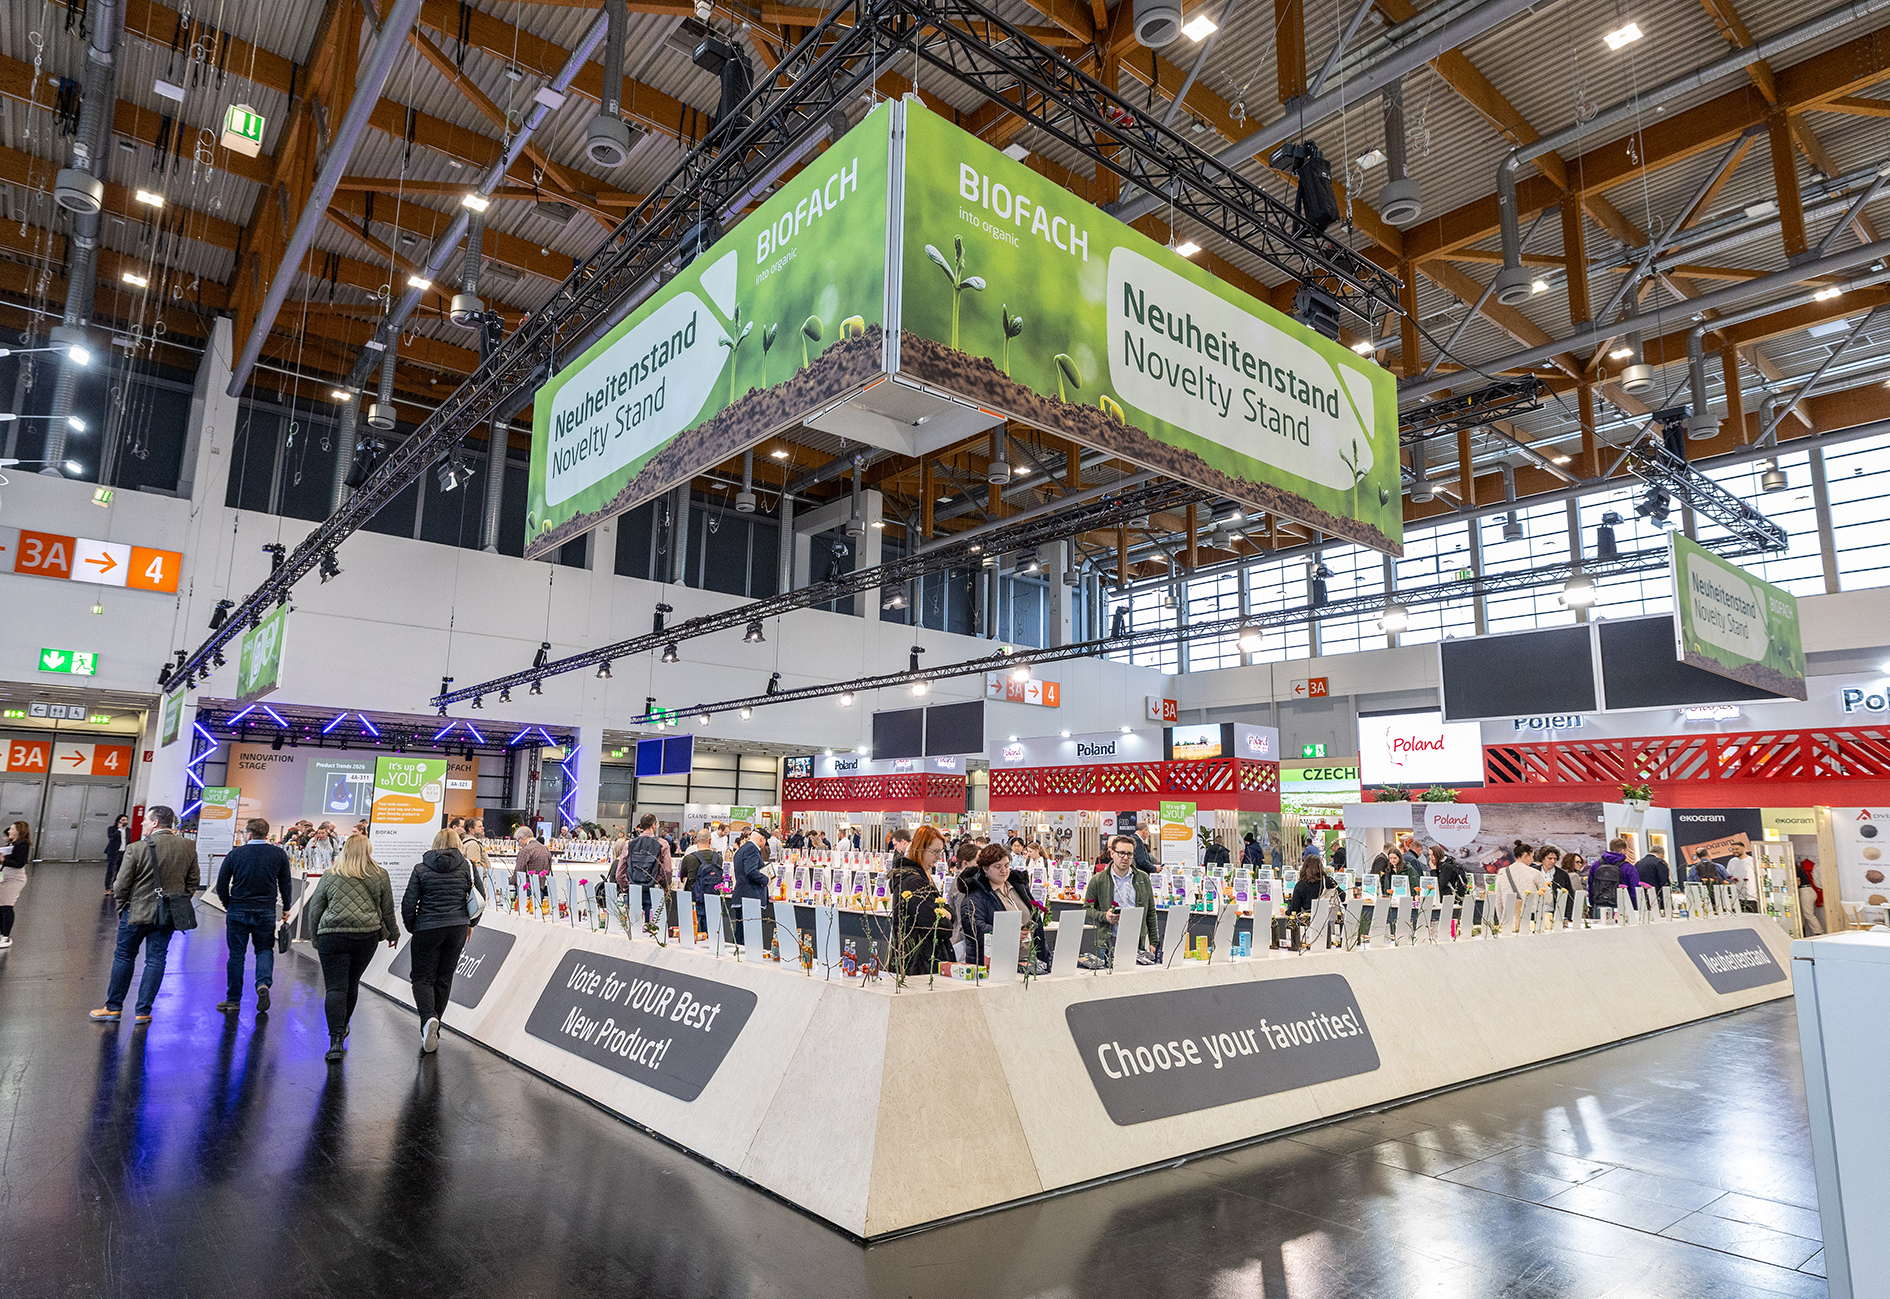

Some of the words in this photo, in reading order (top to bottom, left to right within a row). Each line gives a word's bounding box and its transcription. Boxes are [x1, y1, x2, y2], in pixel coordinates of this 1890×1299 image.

[756, 156, 858, 266] BIOFACH
[959, 161, 1089, 262] BIOFACH
[958, 206, 980, 228] into
[982, 219, 1019, 249] organic
[755, 266, 769, 286] into
[770, 247, 797, 279] organic
[1123, 281, 1340, 419] Neuheitenstand
[554, 310, 698, 442] Neuheitenstand
[1123, 331, 1232, 418] Novelty
[1243, 390, 1311, 447] Stand
[552, 420, 609, 480] Novelty
[614, 377, 667, 439] Stand
[21, 538, 68, 572] 3A
[144, 556, 164, 584] 4
[1691, 571, 1757, 619] Neuheitenstand
[1694, 597, 1726, 634] Novelty
[1727, 613, 1749, 640] Stand
[1769, 596, 1794, 621] BIOFACH
[1008, 680, 1023, 698] 3A
[1048, 685, 1055, 703] 4
[1310, 681, 1326, 695] 3A
[1843, 686, 1890, 712] Pol
[1164, 702, 1177, 718] 3A
[1077, 741, 1116, 756] Poland
[1393, 734, 1445, 752] Poland
[11, 745, 44, 767] 3A
[104, 750, 118, 770] 4
[238, 762, 267, 771] STAGE
[239, 753, 294, 763] INNOVATION
[389, 762, 402, 770] It's
[404, 764, 416, 772] up
[834, 758, 858, 771] Poland
[380, 777, 390, 786] to
[388, 771, 423, 787] YOU!
[1303, 767, 1360, 780] CZECHI
[1166, 810, 1185, 819] YOU!
[1433, 814, 1469, 825] Poland
[1456, 824, 1472, 832] good
[454, 947, 486, 979] tand
[1699, 945, 1772, 975] Neuheitenstand
[566, 962, 601, 996] Vote
[598, 971, 627, 1002] for
[624, 978, 676, 1018] YOUR
[670, 991, 721, 1033] Best
[560, 1005, 599, 1042] New
[594, 1017, 673, 1070] Product!
[1097, 1038, 1203, 1079] Choose
[1201, 1027, 1260, 1070] your
[1260, 1006, 1364, 1050] favorites!
